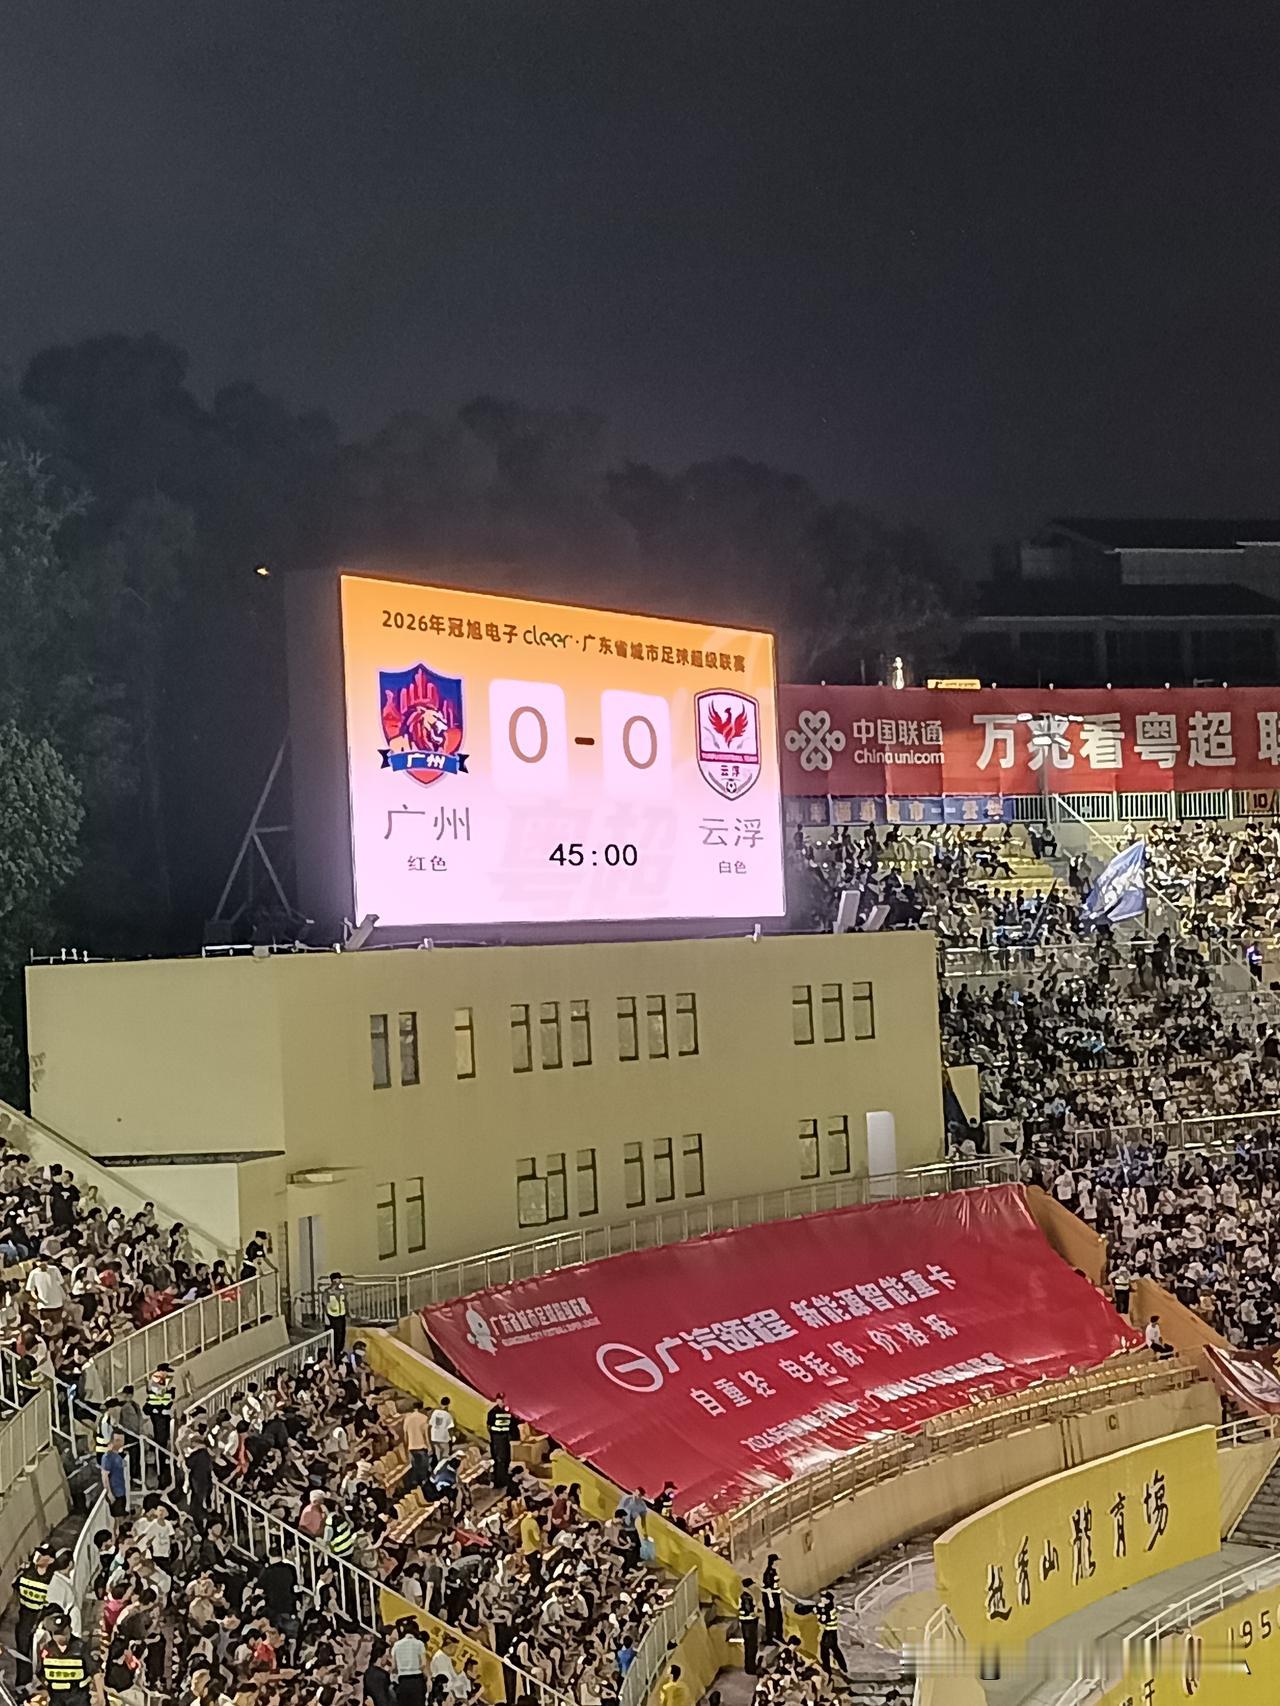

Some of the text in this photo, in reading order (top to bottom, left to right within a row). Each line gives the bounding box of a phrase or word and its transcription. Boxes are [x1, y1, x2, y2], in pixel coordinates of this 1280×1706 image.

[508, 706, 548, 763] 0
[622, 715, 657, 769] 0
[852, 718, 944, 745] 中国联通
[384, 804, 471, 840] 广州
[698, 817, 764, 848] 云浮
[407, 855, 448, 871] 红色
[549, 843, 638, 866] 45:00
[718, 860, 747, 874] 白色
[655, 1308, 799, 1373] 广汽领程
[790, 1264, 957, 1329] 新能源智能重卡
[1228, 1604, 1280, 1648] 195
